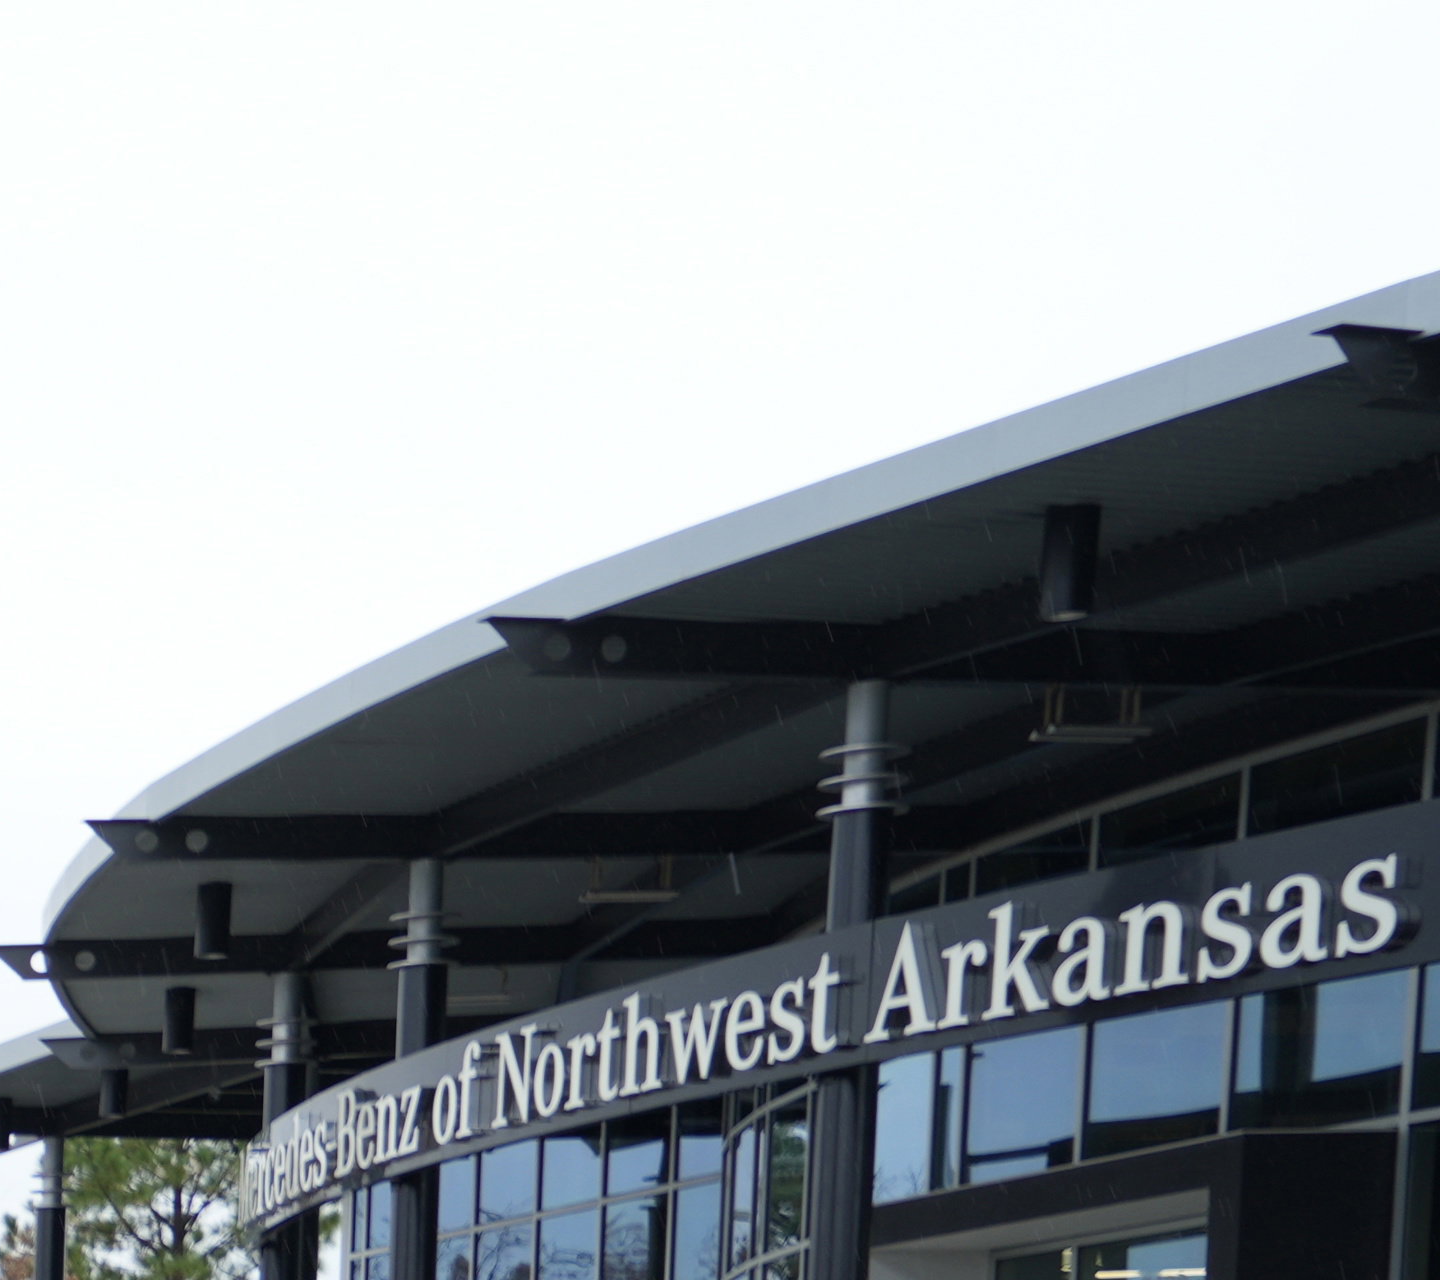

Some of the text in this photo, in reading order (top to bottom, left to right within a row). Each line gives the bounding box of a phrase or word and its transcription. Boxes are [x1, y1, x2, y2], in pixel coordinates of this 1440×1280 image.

[238, 853, 1398, 1229] Mercedes-Benz of Northwest Arkansas
